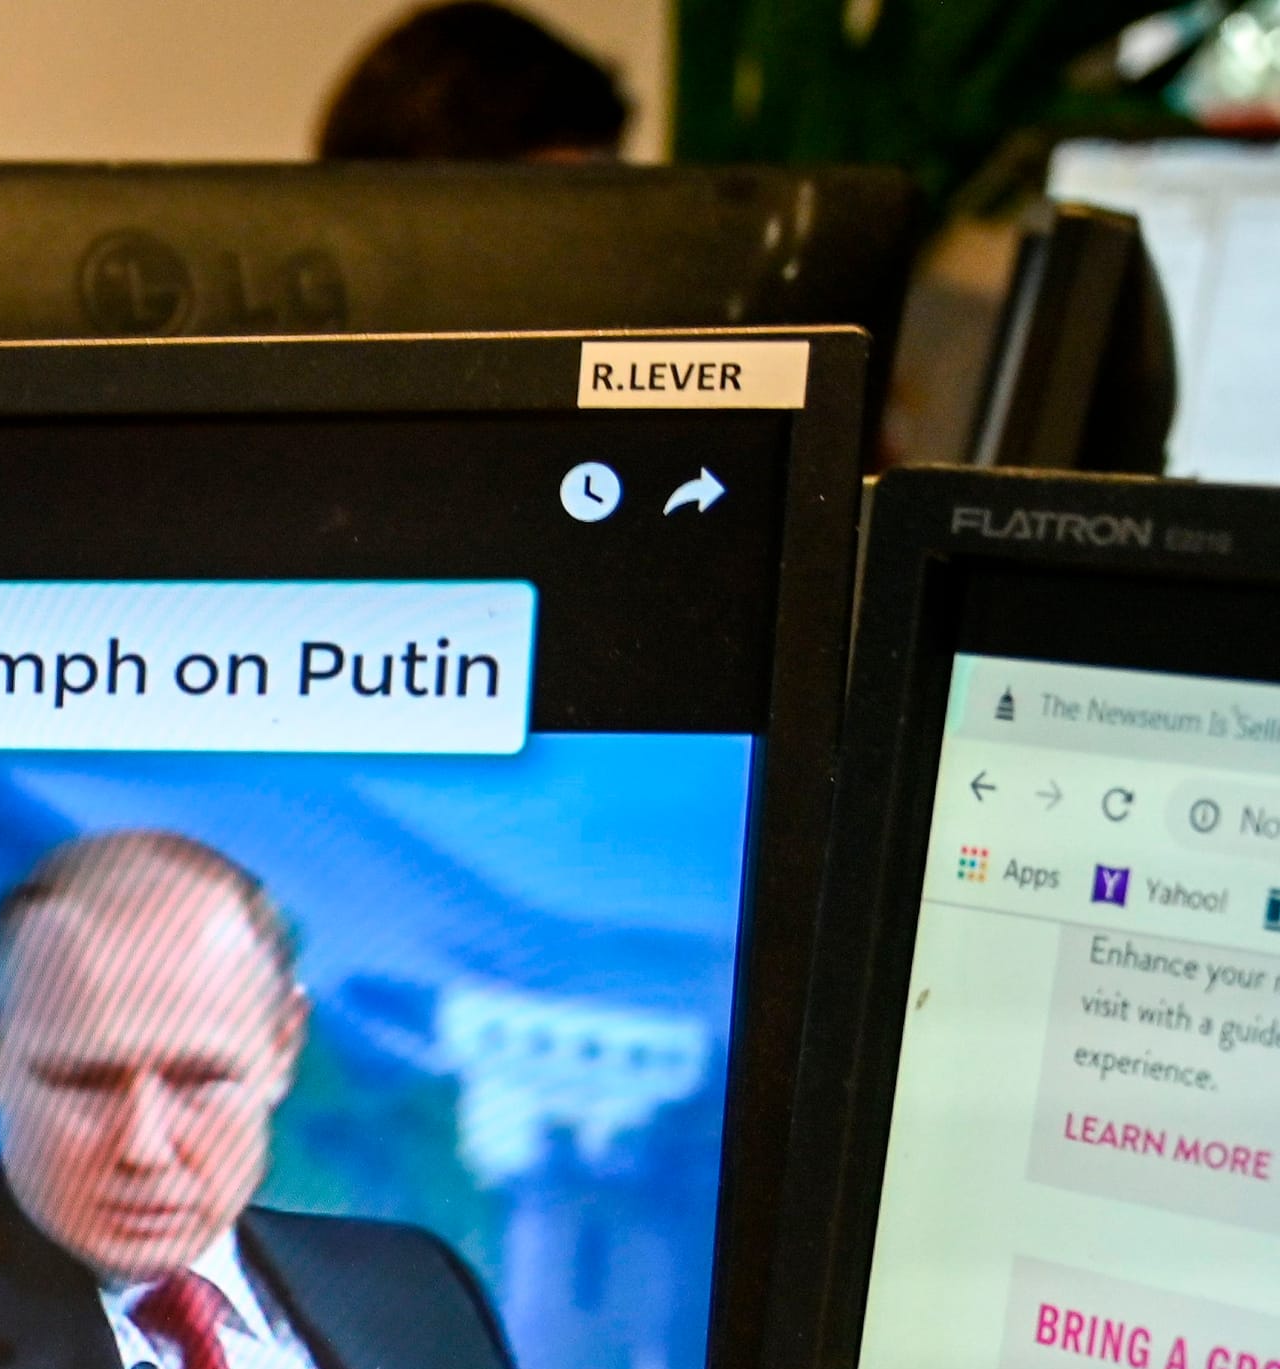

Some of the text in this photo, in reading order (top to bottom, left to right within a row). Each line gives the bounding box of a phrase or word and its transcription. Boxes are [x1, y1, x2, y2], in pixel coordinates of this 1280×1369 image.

[591, 361, 742, 393] R.LEVER
[951, 507, 1153, 546] FLATRON
[174, 651, 266, 695] on
[299, 636, 500, 698] Putin
[1041, 693, 1081, 721] The
[1087, 698, 1201, 733] Newseum
[1003, 859, 1228, 912] Apps Yahoo!
[1090, 936, 1265, 992] Enhance your
[1081, 988, 1129, 1022] visit
[1139, 1000, 1191, 1033] with
[1199, 1017, 1212, 1035] a
[1074, 1046, 1218, 1092] experience.
[1064, 1112, 1273, 1180] LEARN MORE
